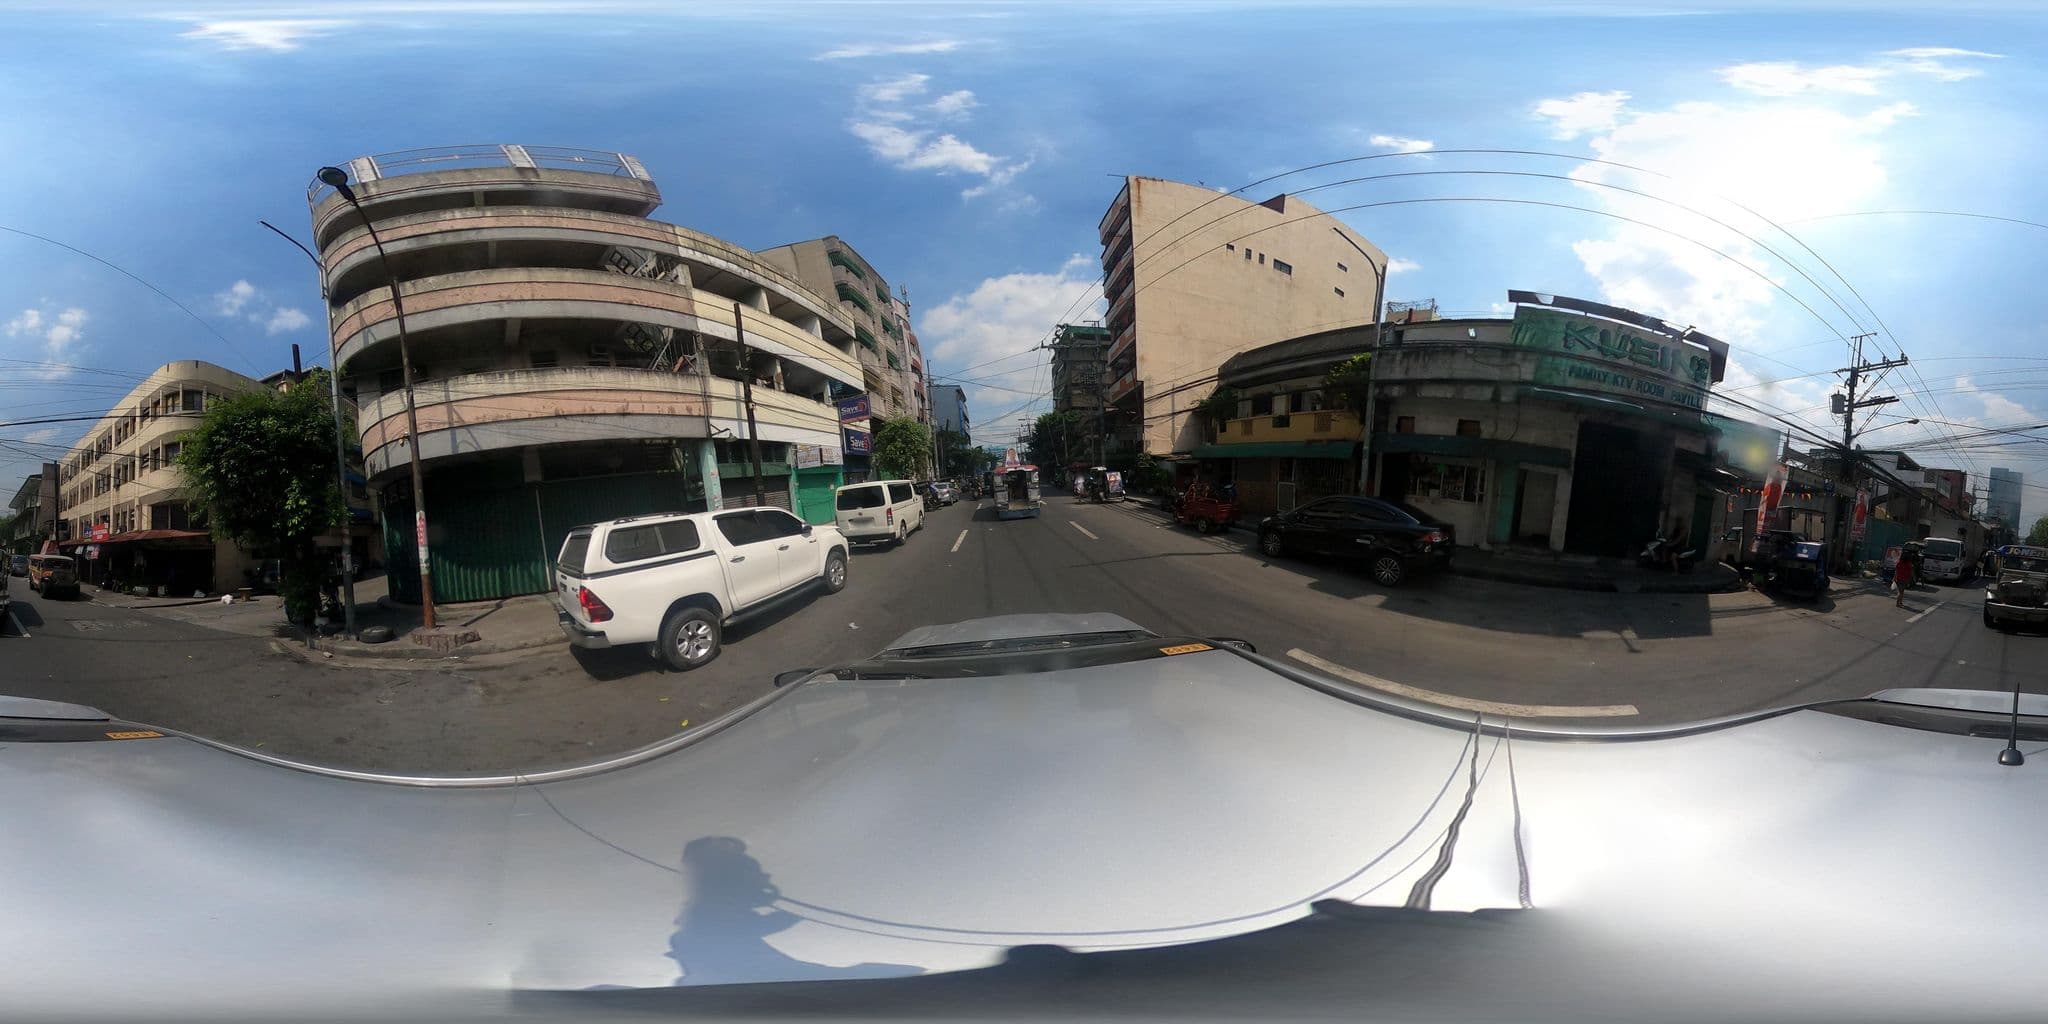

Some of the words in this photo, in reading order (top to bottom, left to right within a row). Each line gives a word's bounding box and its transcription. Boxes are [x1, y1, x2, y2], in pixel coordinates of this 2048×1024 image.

[1568, 365, 1607, 383] FAMILY
[1612, 374, 1632, 390] KTV
[1635, 379, 1665, 397] ROOM
